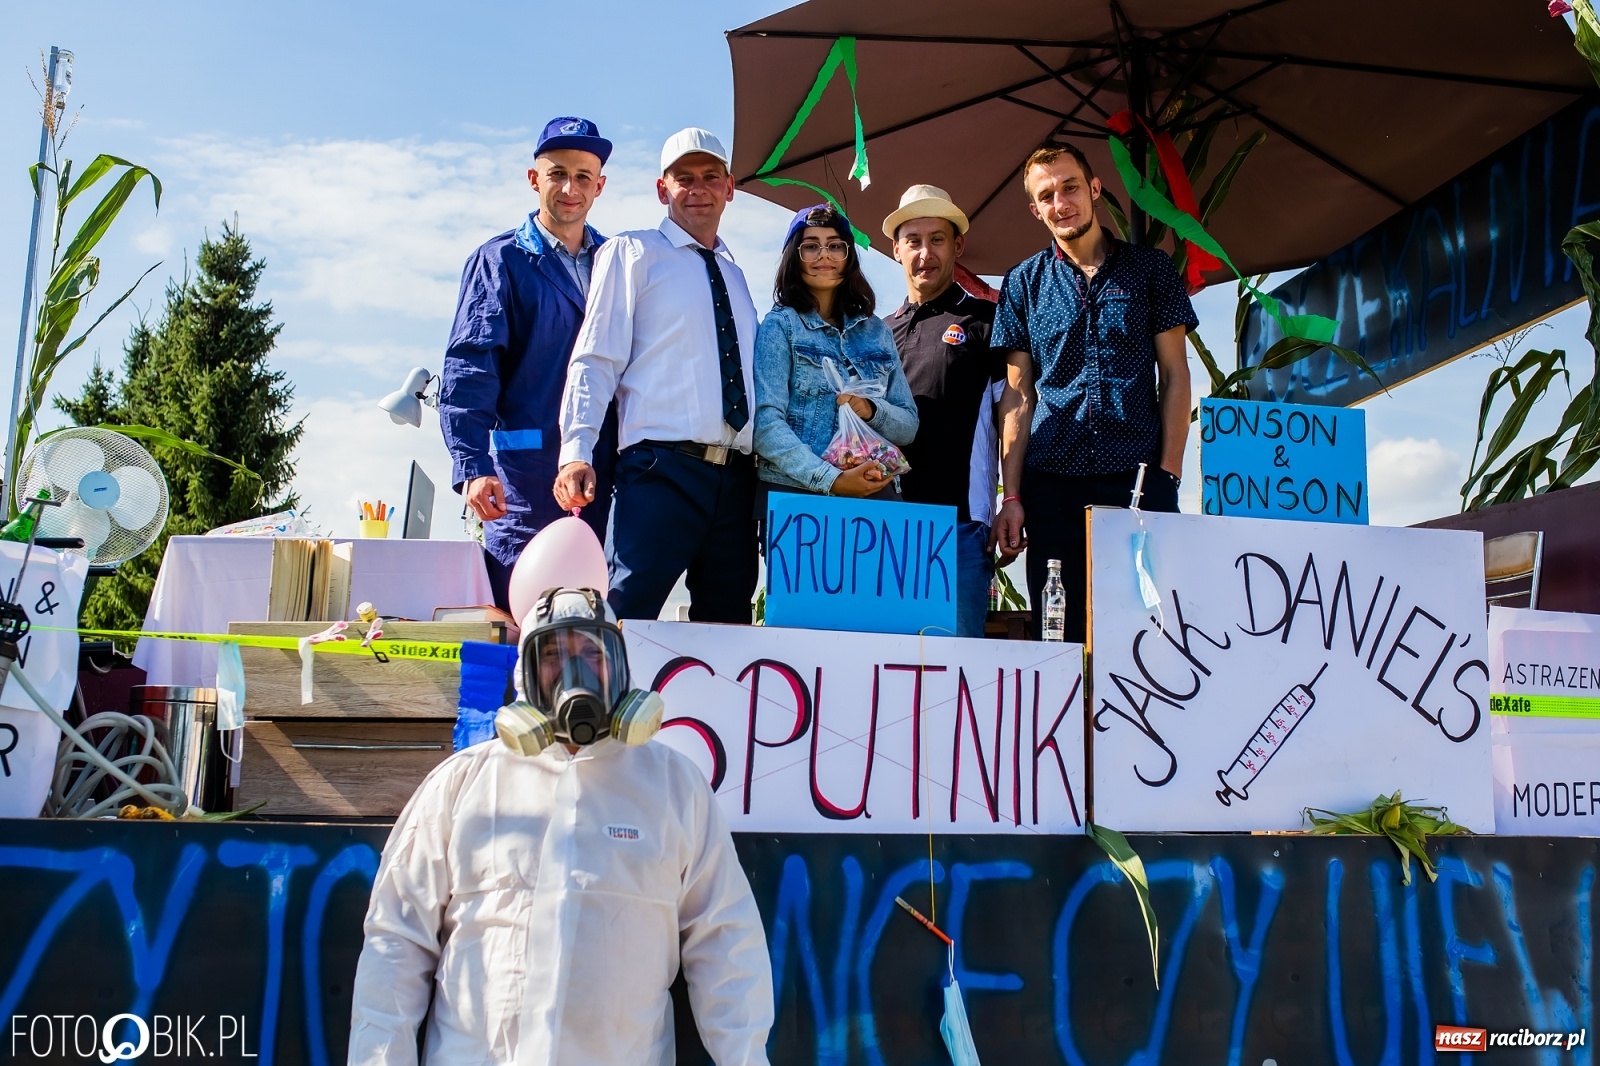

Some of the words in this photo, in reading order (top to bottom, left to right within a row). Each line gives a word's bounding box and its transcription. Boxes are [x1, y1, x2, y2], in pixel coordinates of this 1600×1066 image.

[1201, 404, 1337, 446] JONSON
[1273, 444, 1290, 468] &
[1203, 472, 1363, 517] JONSON
[767, 509, 954, 602] KRUPNIK
[35, 581, 60, 615] &
[389, 644, 460, 659] SideXaf
[1093, 589, 1231, 787] JACK
[1234, 552, 1490, 743] DANIEL'S
[1503, 662, 1600, 690] ASTRAZEN
[650, 655, 1082, 828] SPUTNIK
[1513, 781, 1600, 818] MODER
[608, 826, 639, 839] TECTOR
